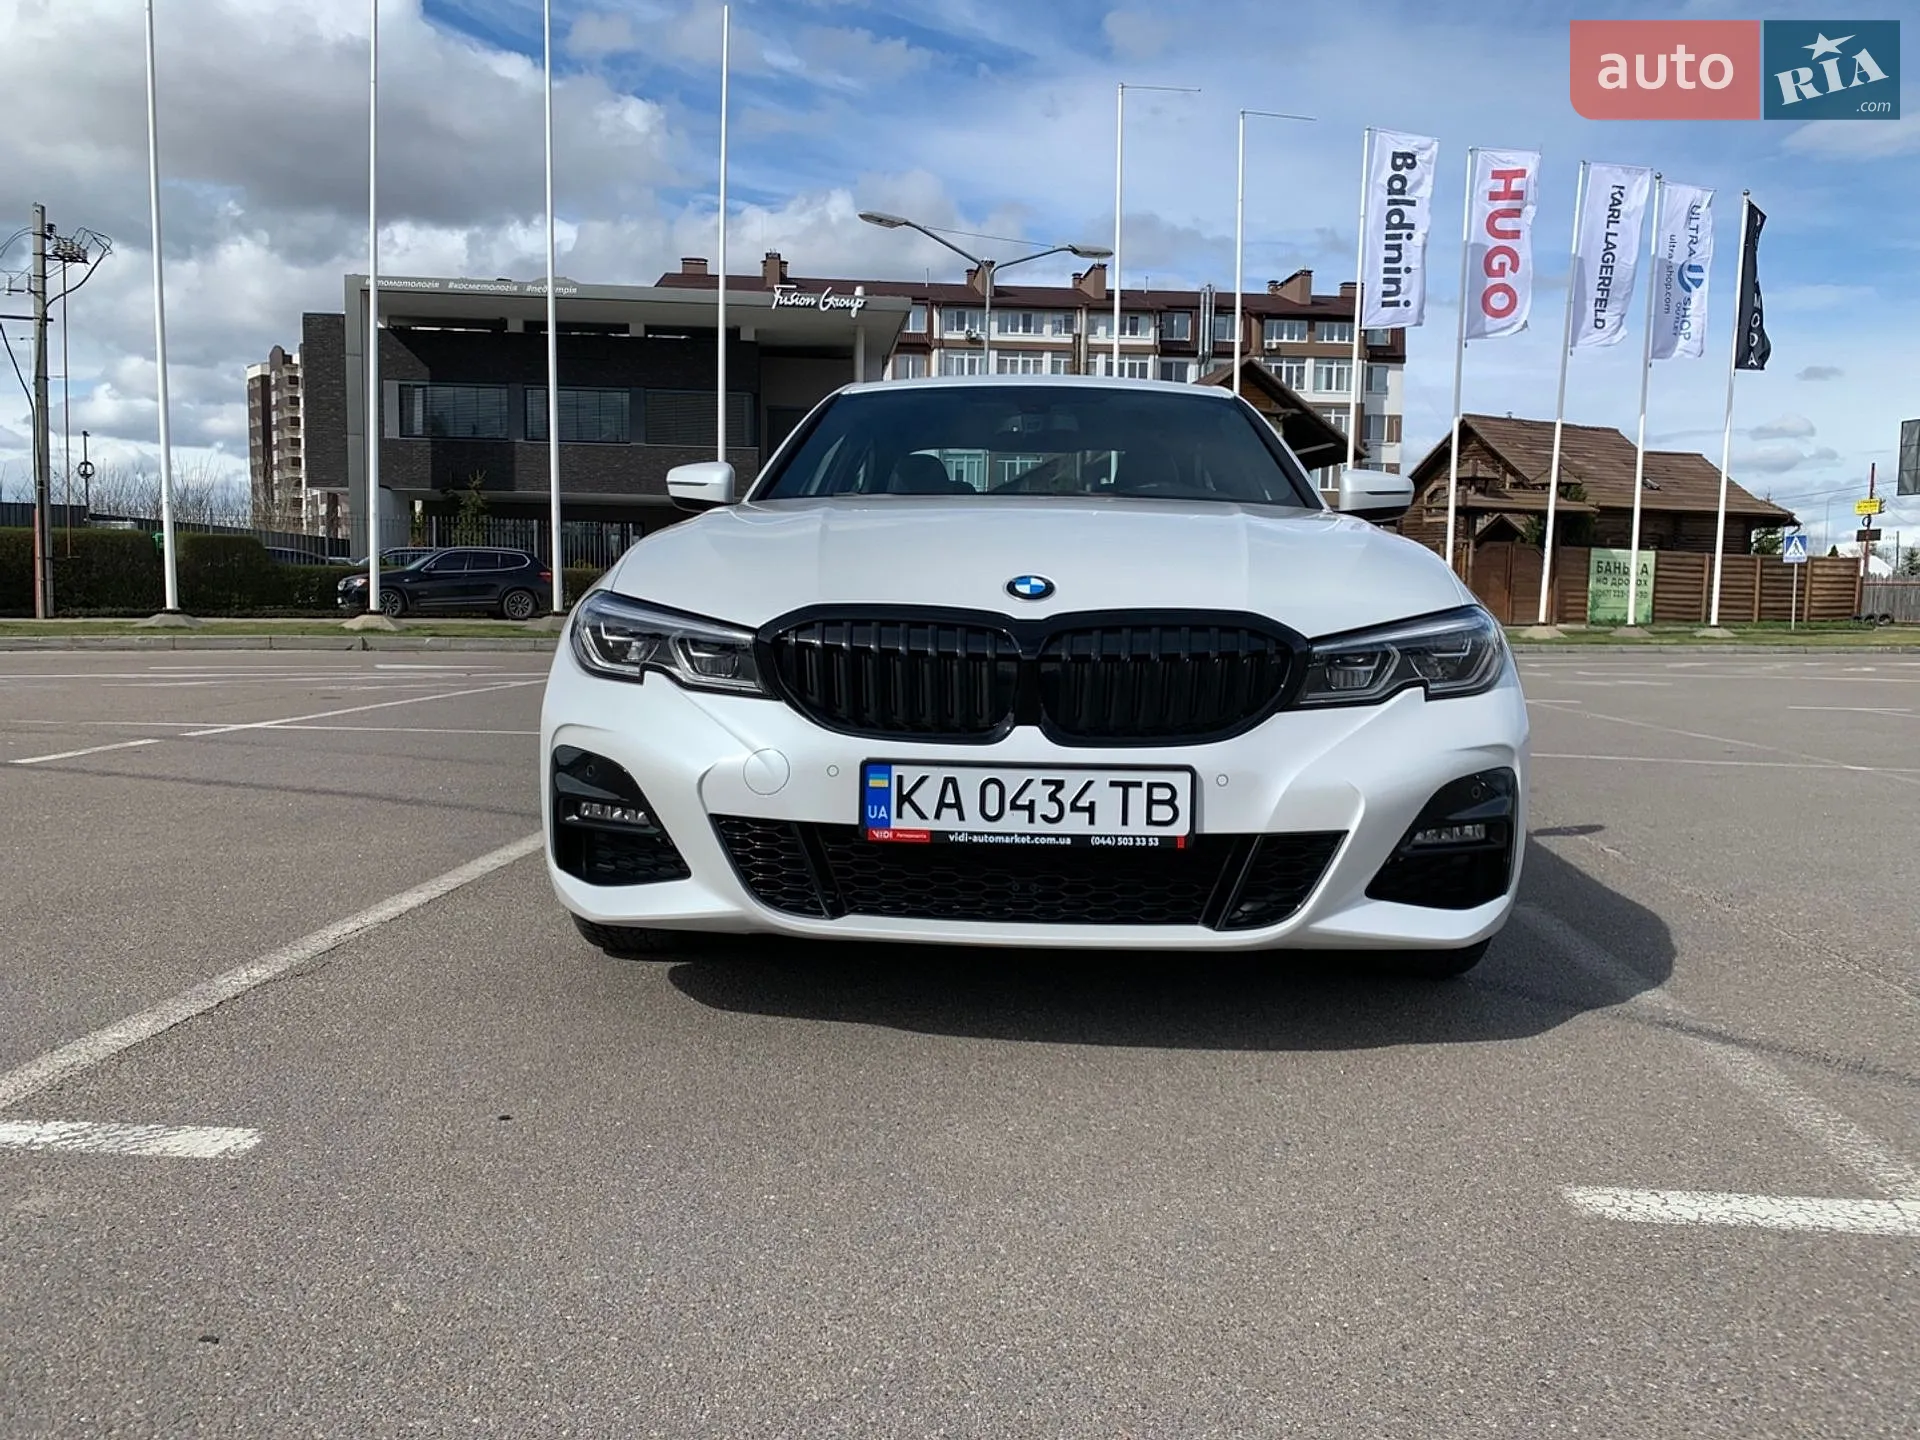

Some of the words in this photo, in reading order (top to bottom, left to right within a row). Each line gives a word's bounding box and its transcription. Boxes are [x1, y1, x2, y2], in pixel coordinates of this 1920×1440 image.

[1380, 150, 1417, 309] Baldinini
[1606, 184, 1626, 231] KARL
[1481, 168, 1527, 319] HUGO
[1688, 204, 1702, 257] ULTRA
[366, 278, 440, 289] #томатологія
[771, 284, 817, 310] Fusion
[819, 286, 867, 318] Group
[1594, 231, 1619, 330] LAGERFELD
[1679, 297, 1692, 341] SHOP
[1596, 560, 1649, 576] БАНЬА
[1610, 578, 1648, 589] дроах
[867, 804, 888, 820] UA
[895, 774, 966, 822] KA
[979, 777, 1096, 826] 0434
[1108, 780, 1180, 828] TB
[948, 832, 1072, 846] vidi-automarket.com.ua
[1090, 835, 1116, 847] (044)
[1117, 836, 1133, 847] 503
[1135, 837, 1147, 847] 33
[1148, 837, 1159, 847] 53
